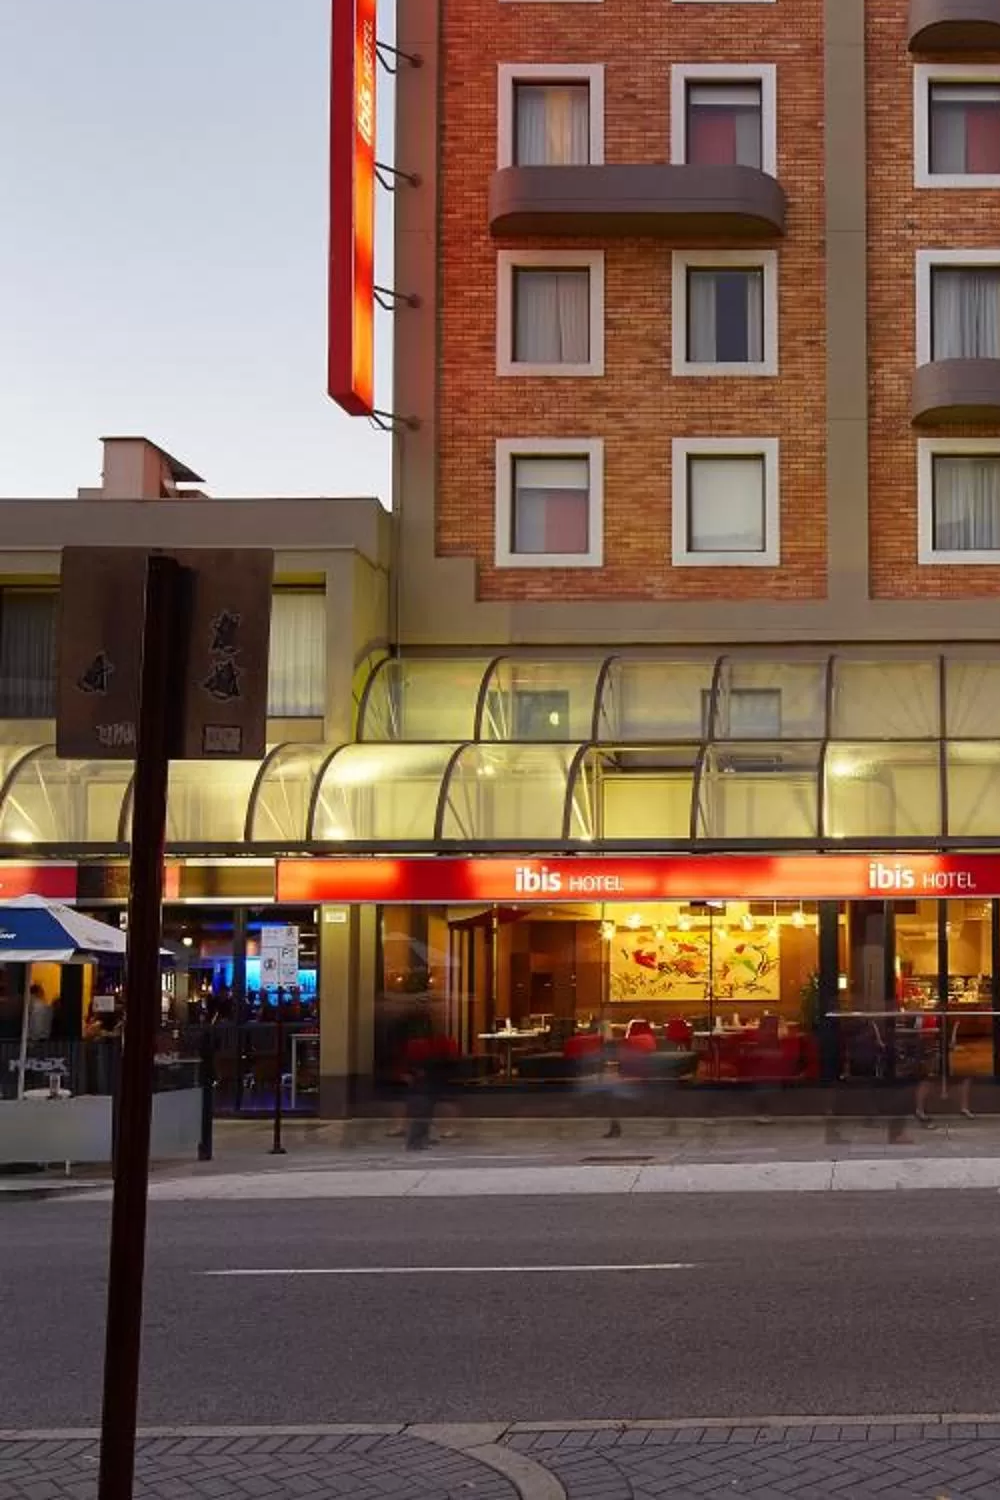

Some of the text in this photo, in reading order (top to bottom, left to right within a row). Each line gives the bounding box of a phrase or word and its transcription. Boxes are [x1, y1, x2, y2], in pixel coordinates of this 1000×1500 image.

[515, 866, 625, 892] ibis HOTEL
[869, 863, 977, 889] ibis HOTEL
